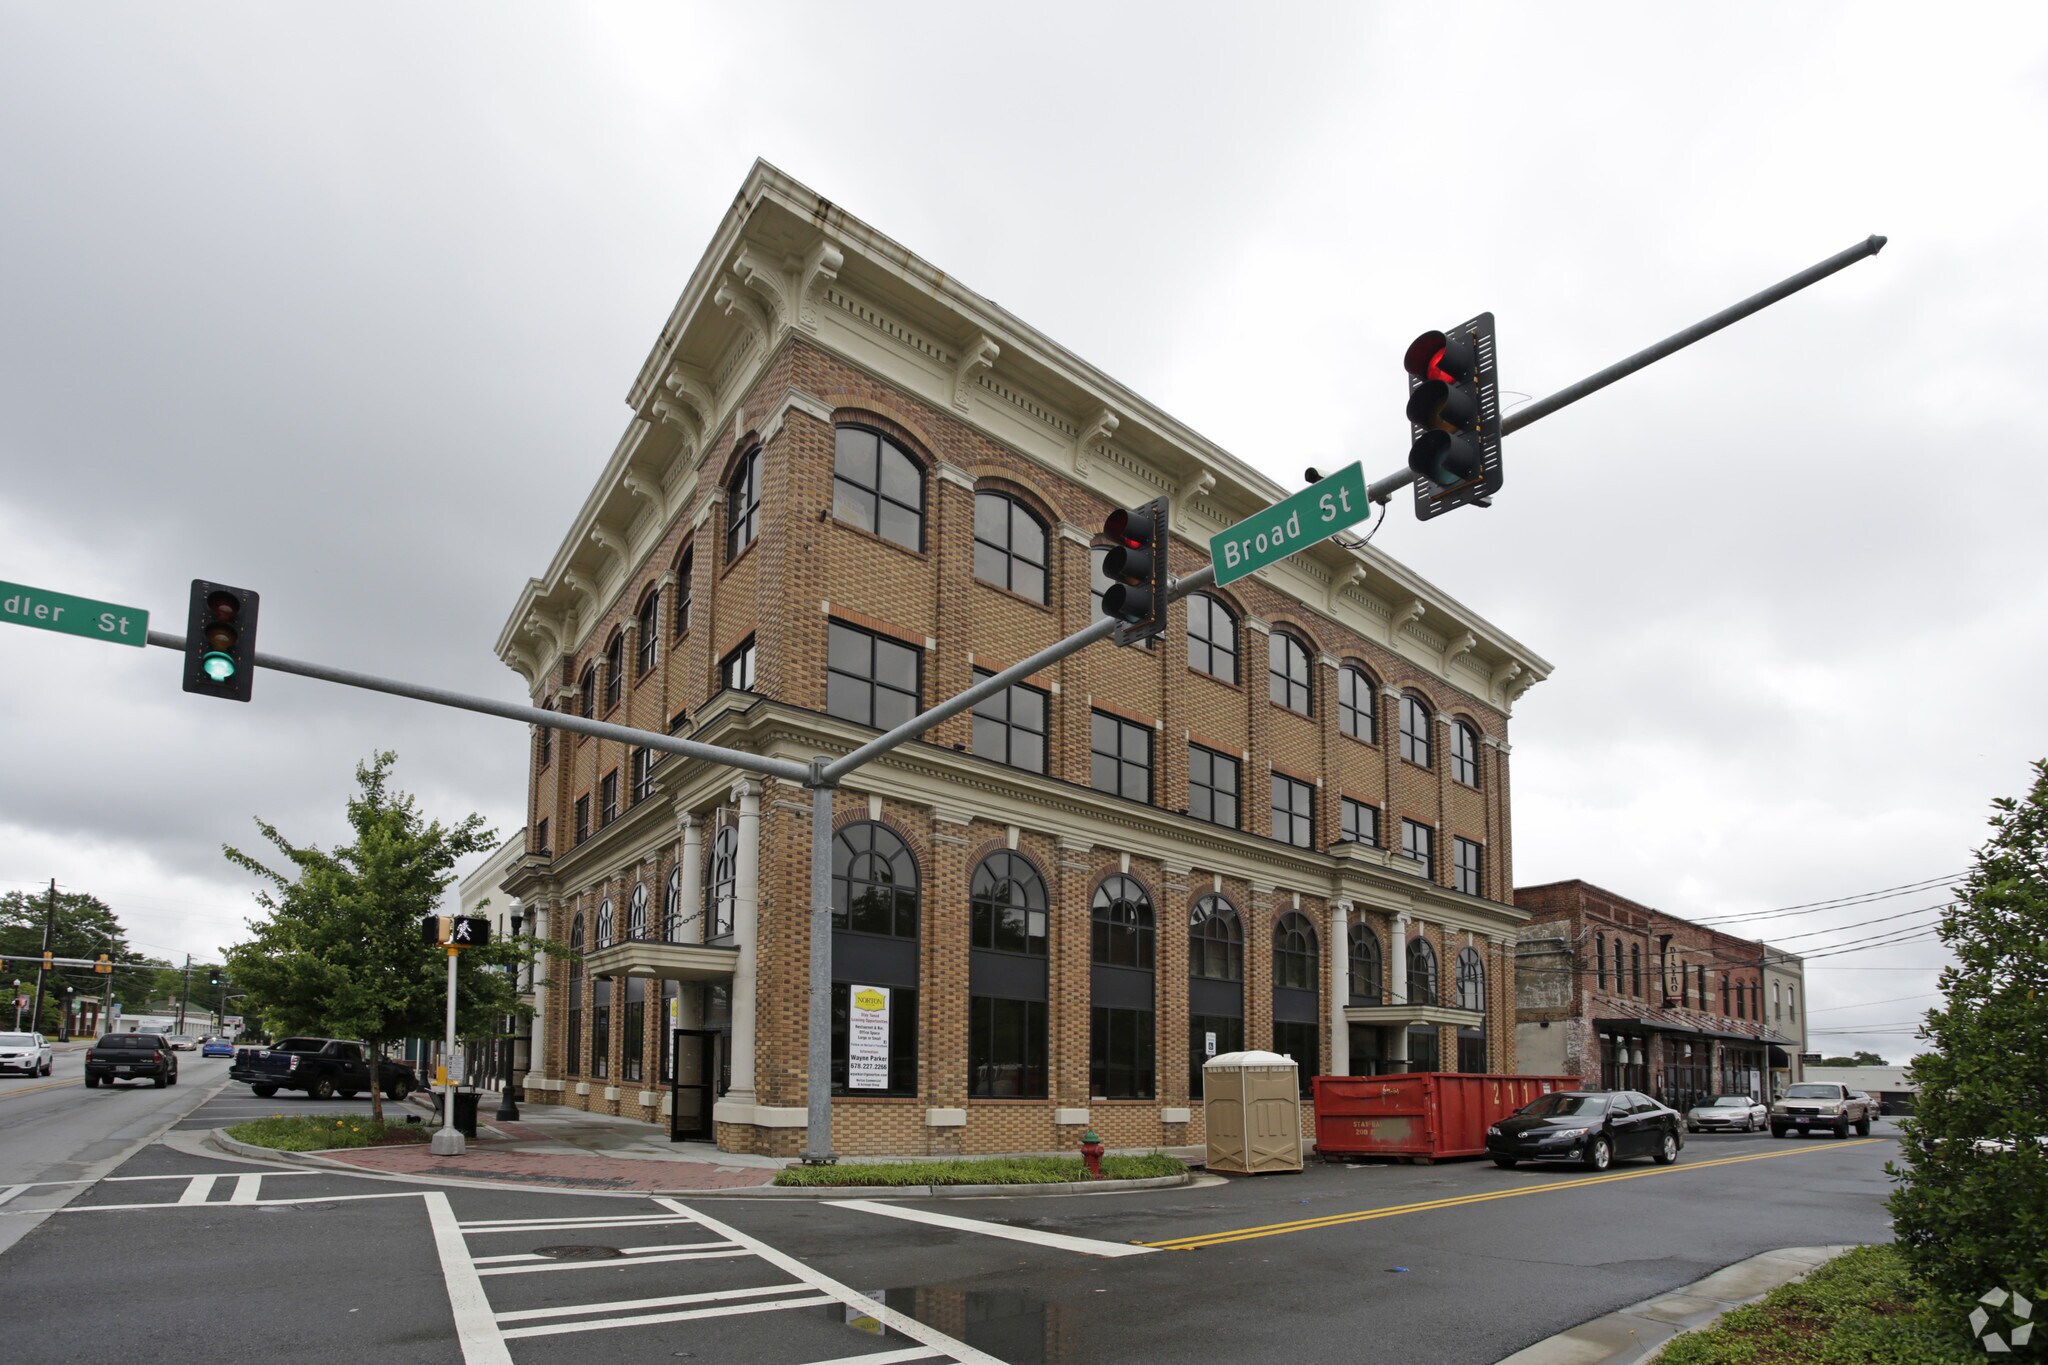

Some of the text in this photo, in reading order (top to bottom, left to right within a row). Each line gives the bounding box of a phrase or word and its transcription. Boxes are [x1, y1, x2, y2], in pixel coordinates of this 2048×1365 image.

[1224, 486, 1352, 569] Broad St
[98, 613, 130, 635] St
